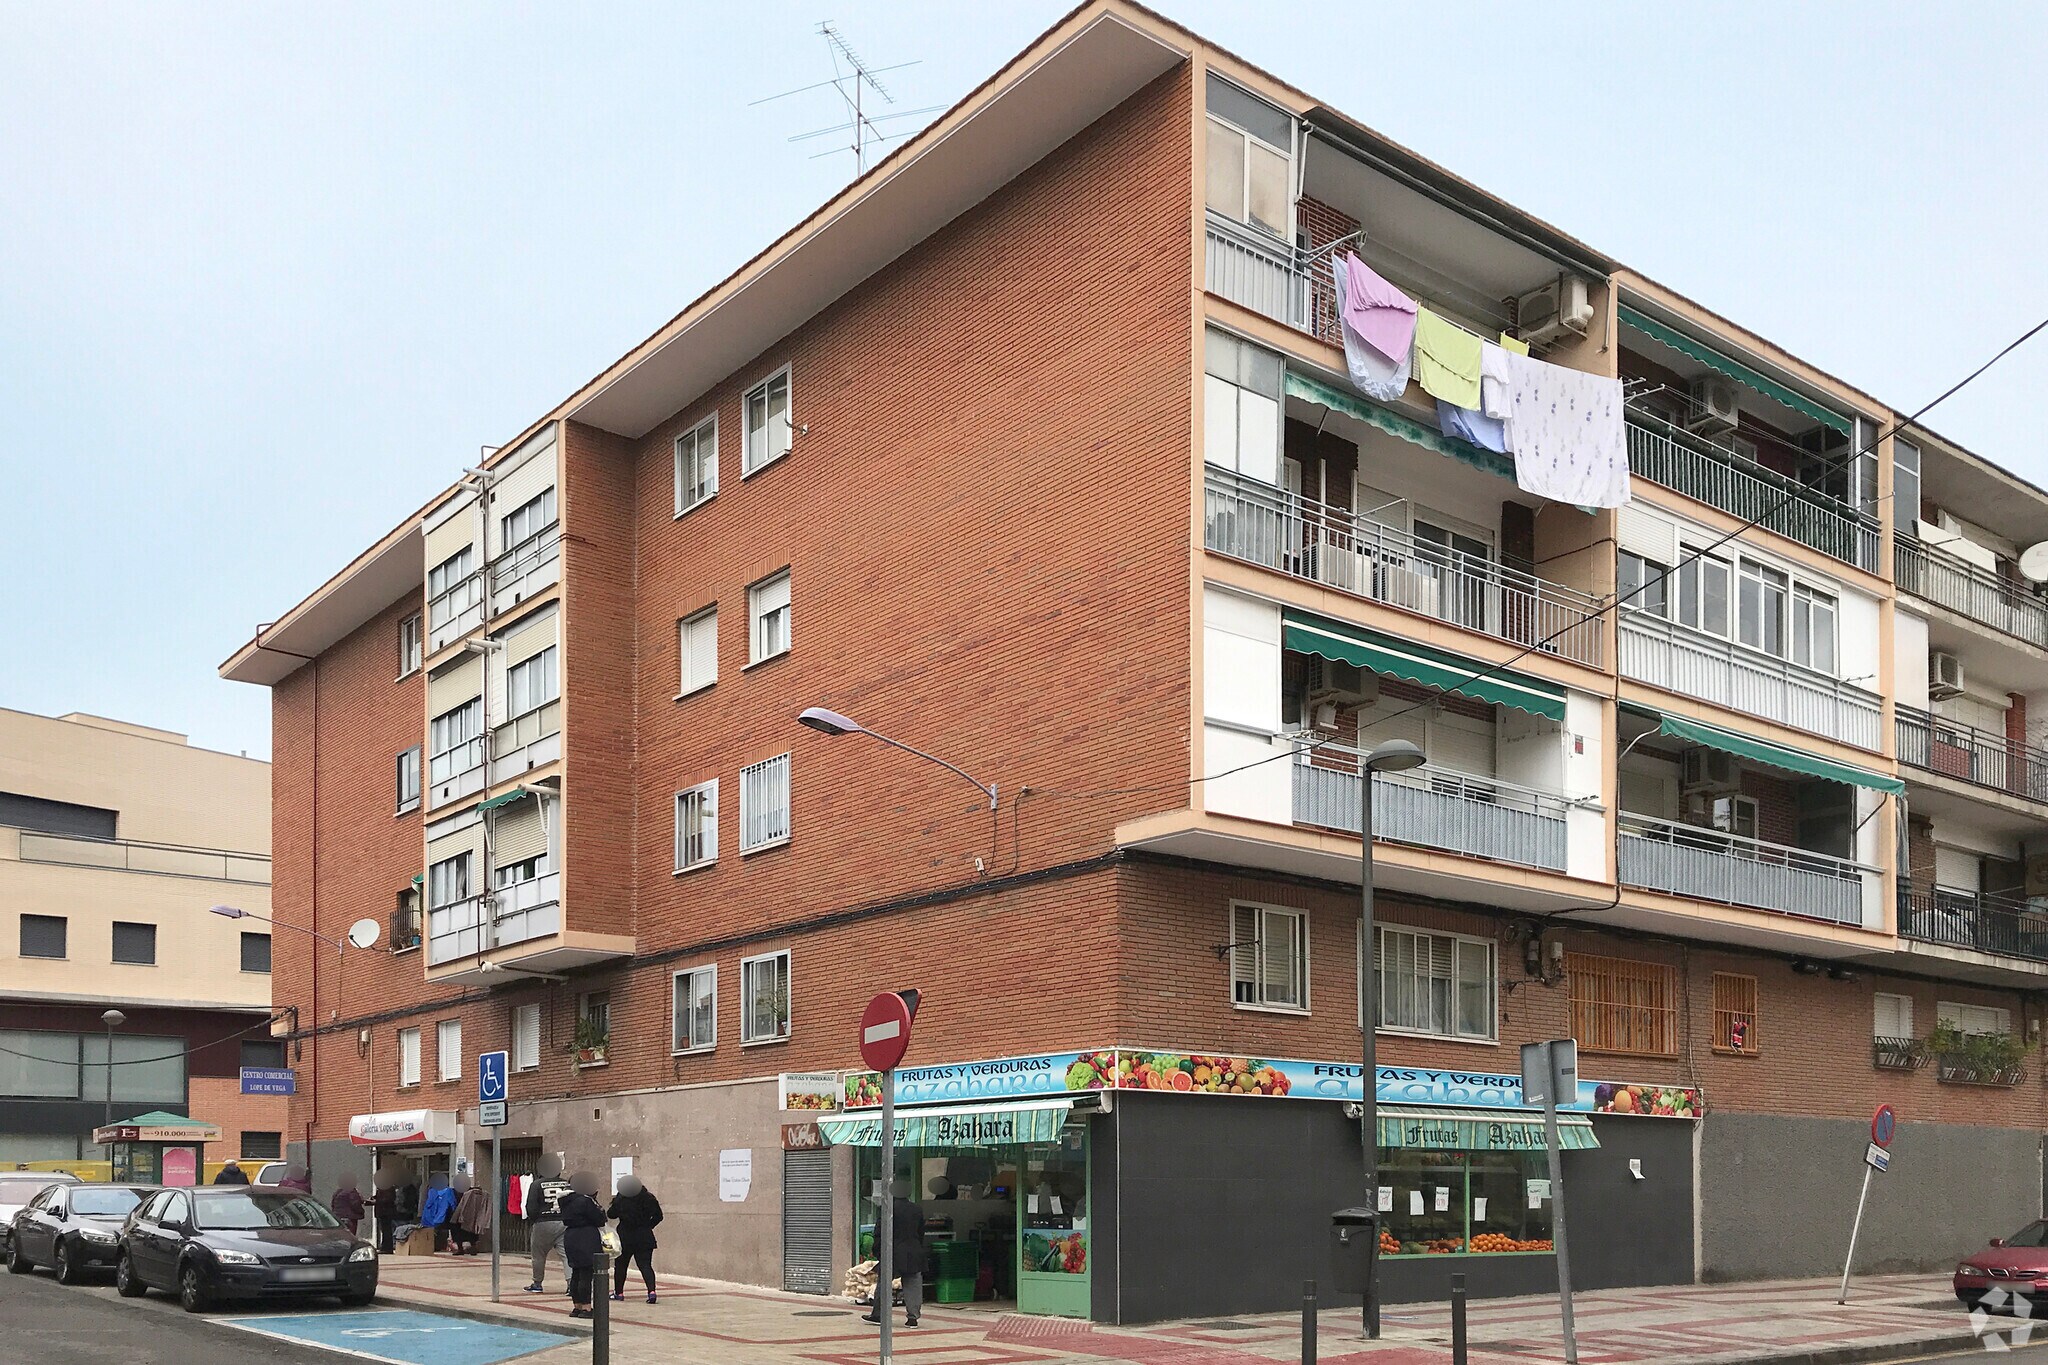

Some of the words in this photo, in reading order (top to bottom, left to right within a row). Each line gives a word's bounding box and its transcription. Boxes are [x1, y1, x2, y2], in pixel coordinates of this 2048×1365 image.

[242, 1071, 264, 1079] CENTRO
[264, 1072, 293, 1080] COMERCIAL
[902, 1068, 953, 1082] FRUTAS
[957, 1066, 967, 1077] Y
[971, 1059, 1051, 1075] VERDURAS
[1314, 1066, 1416, 1081] FRUAS
[1425, 1072, 1441, 1082] Y
[271, 1084, 286, 1092] VEGA
[380, 1123, 393, 1134] Lope
[393, 1121, 399, 1132] de
[400, 1121, 415, 1132] Vega
[853, 1125, 906, 1142] Fruas
[938, 1116, 1012, 1144] Azahara
[1406, 1126, 1458, 1145] Frutas
